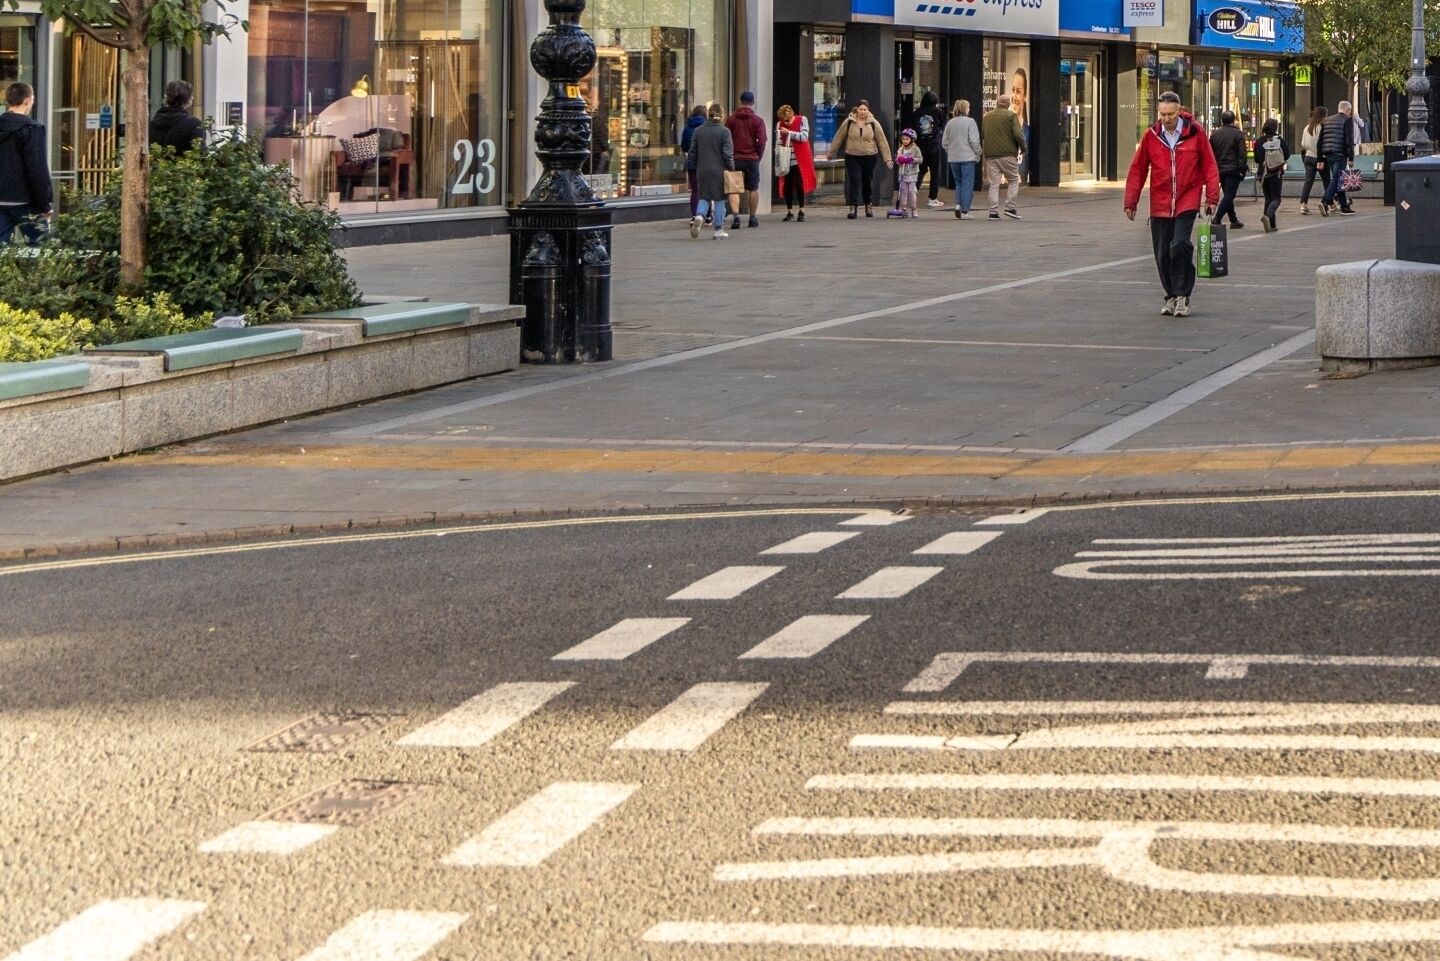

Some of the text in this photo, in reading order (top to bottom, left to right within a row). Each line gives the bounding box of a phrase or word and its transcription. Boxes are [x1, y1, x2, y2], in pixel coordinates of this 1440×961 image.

[1130, 10, 1155, 18] express
[1216, 20, 1237, 30] HILL
[452, 138, 496, 195] 23
